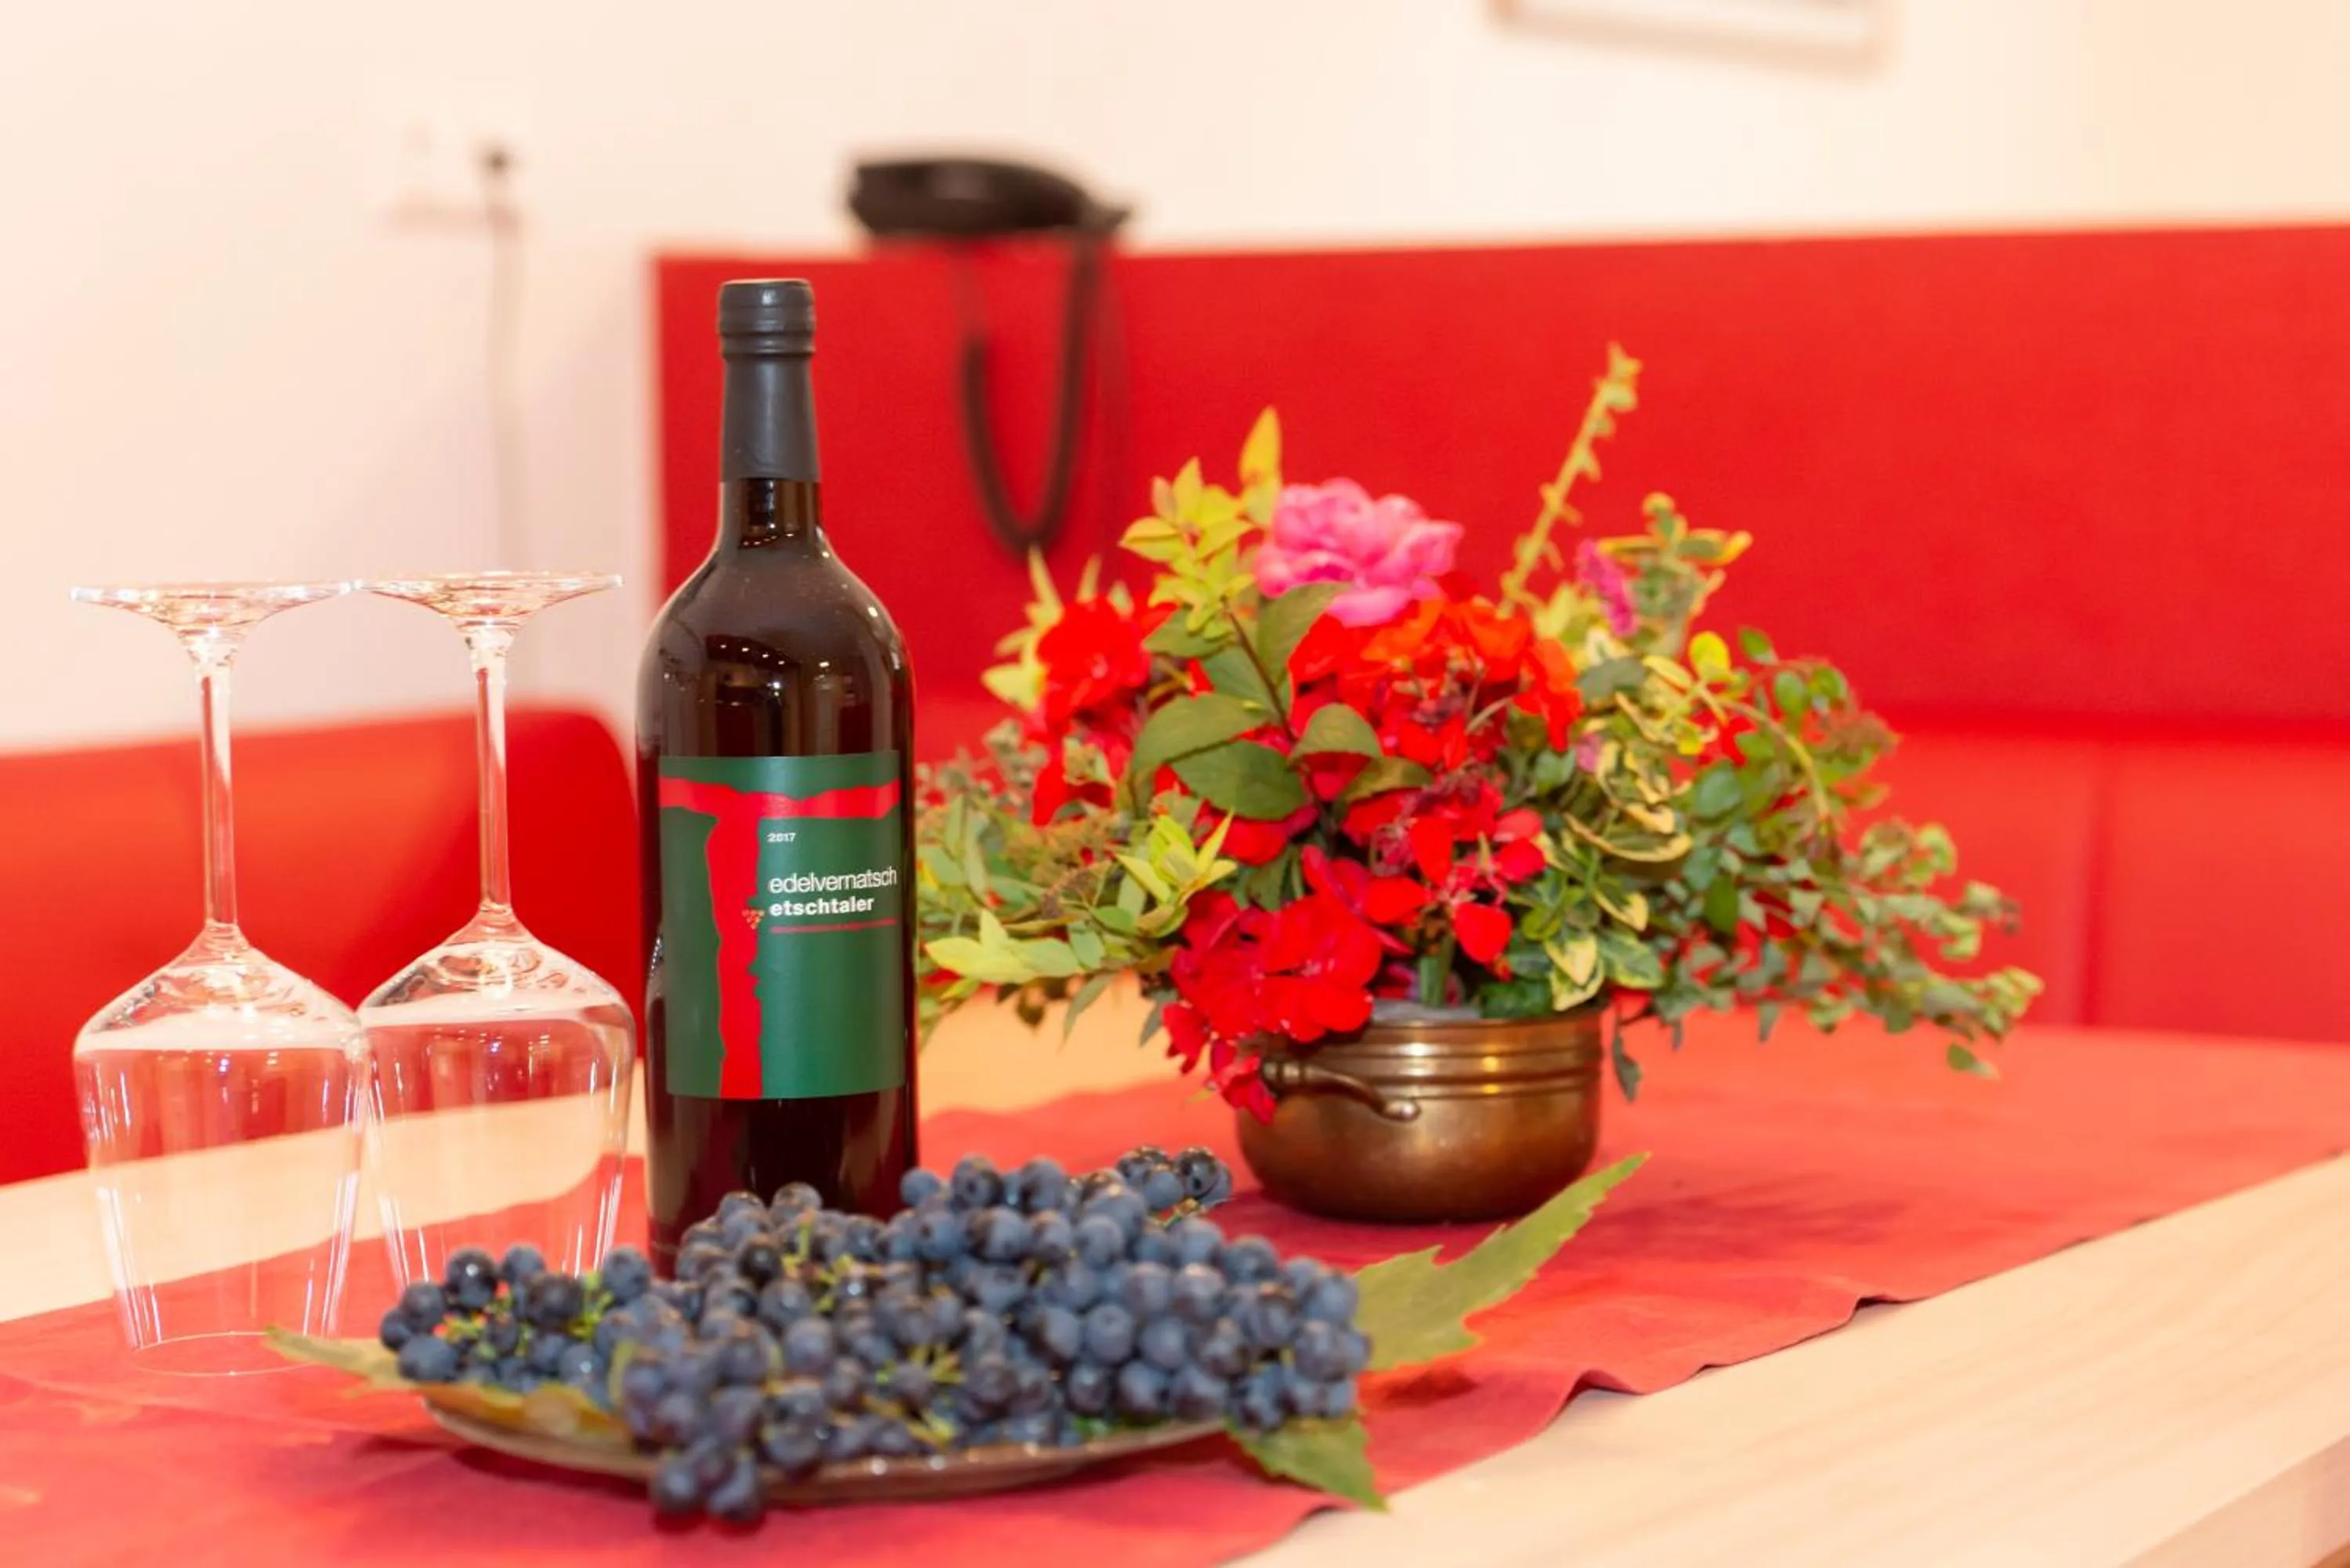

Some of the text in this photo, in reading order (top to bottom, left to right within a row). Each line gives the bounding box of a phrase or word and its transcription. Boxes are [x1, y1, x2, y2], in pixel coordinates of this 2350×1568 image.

[768, 833, 796, 842] 2017
[769, 866, 897, 894] edelvernatsch
[769, 896, 874, 916] etschtaler
